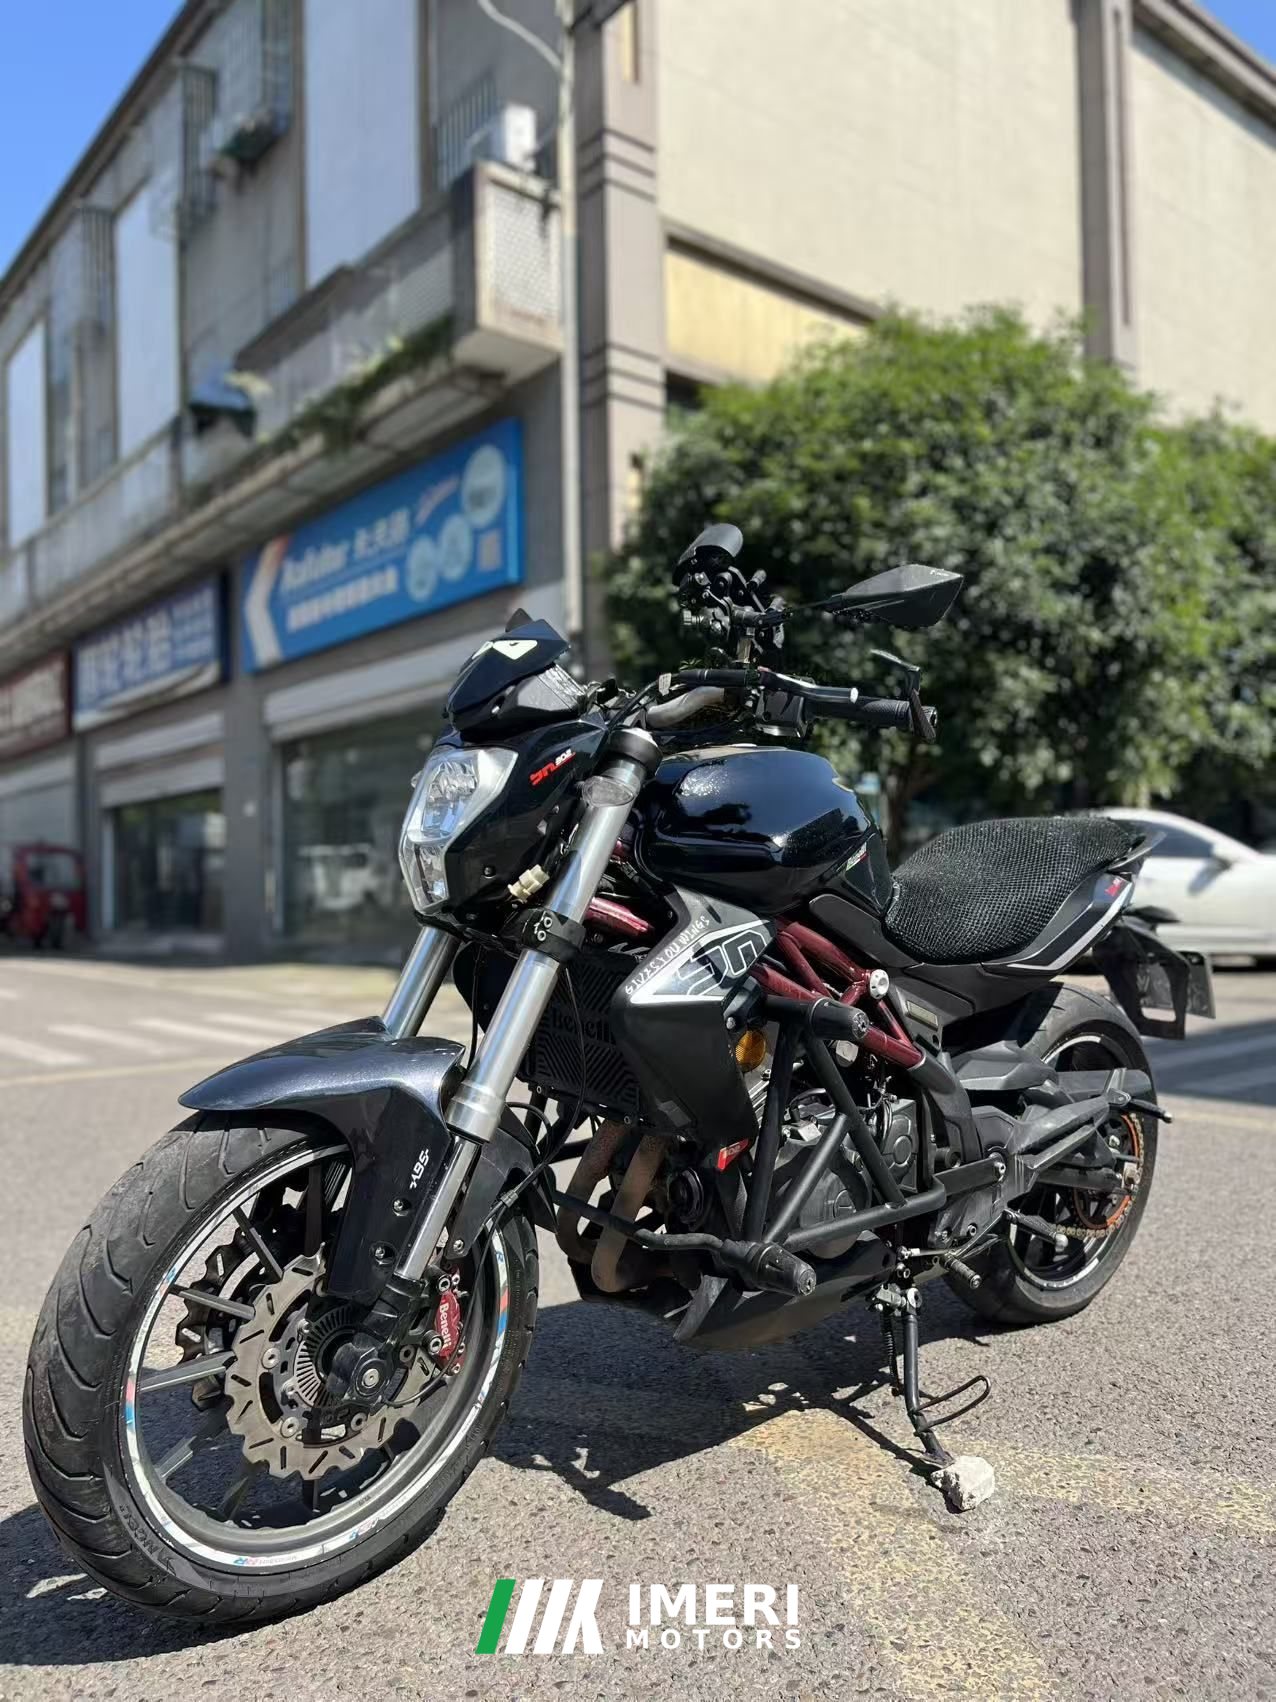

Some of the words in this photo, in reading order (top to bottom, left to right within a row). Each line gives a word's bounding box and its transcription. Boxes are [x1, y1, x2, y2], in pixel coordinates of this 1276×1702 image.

[656, 944, 682, 968] YOU
[679, 915, 710, 946] WINGS
[410, 1149, 429, 1189] ABS
[440, 1302, 453, 1350] Benelli
